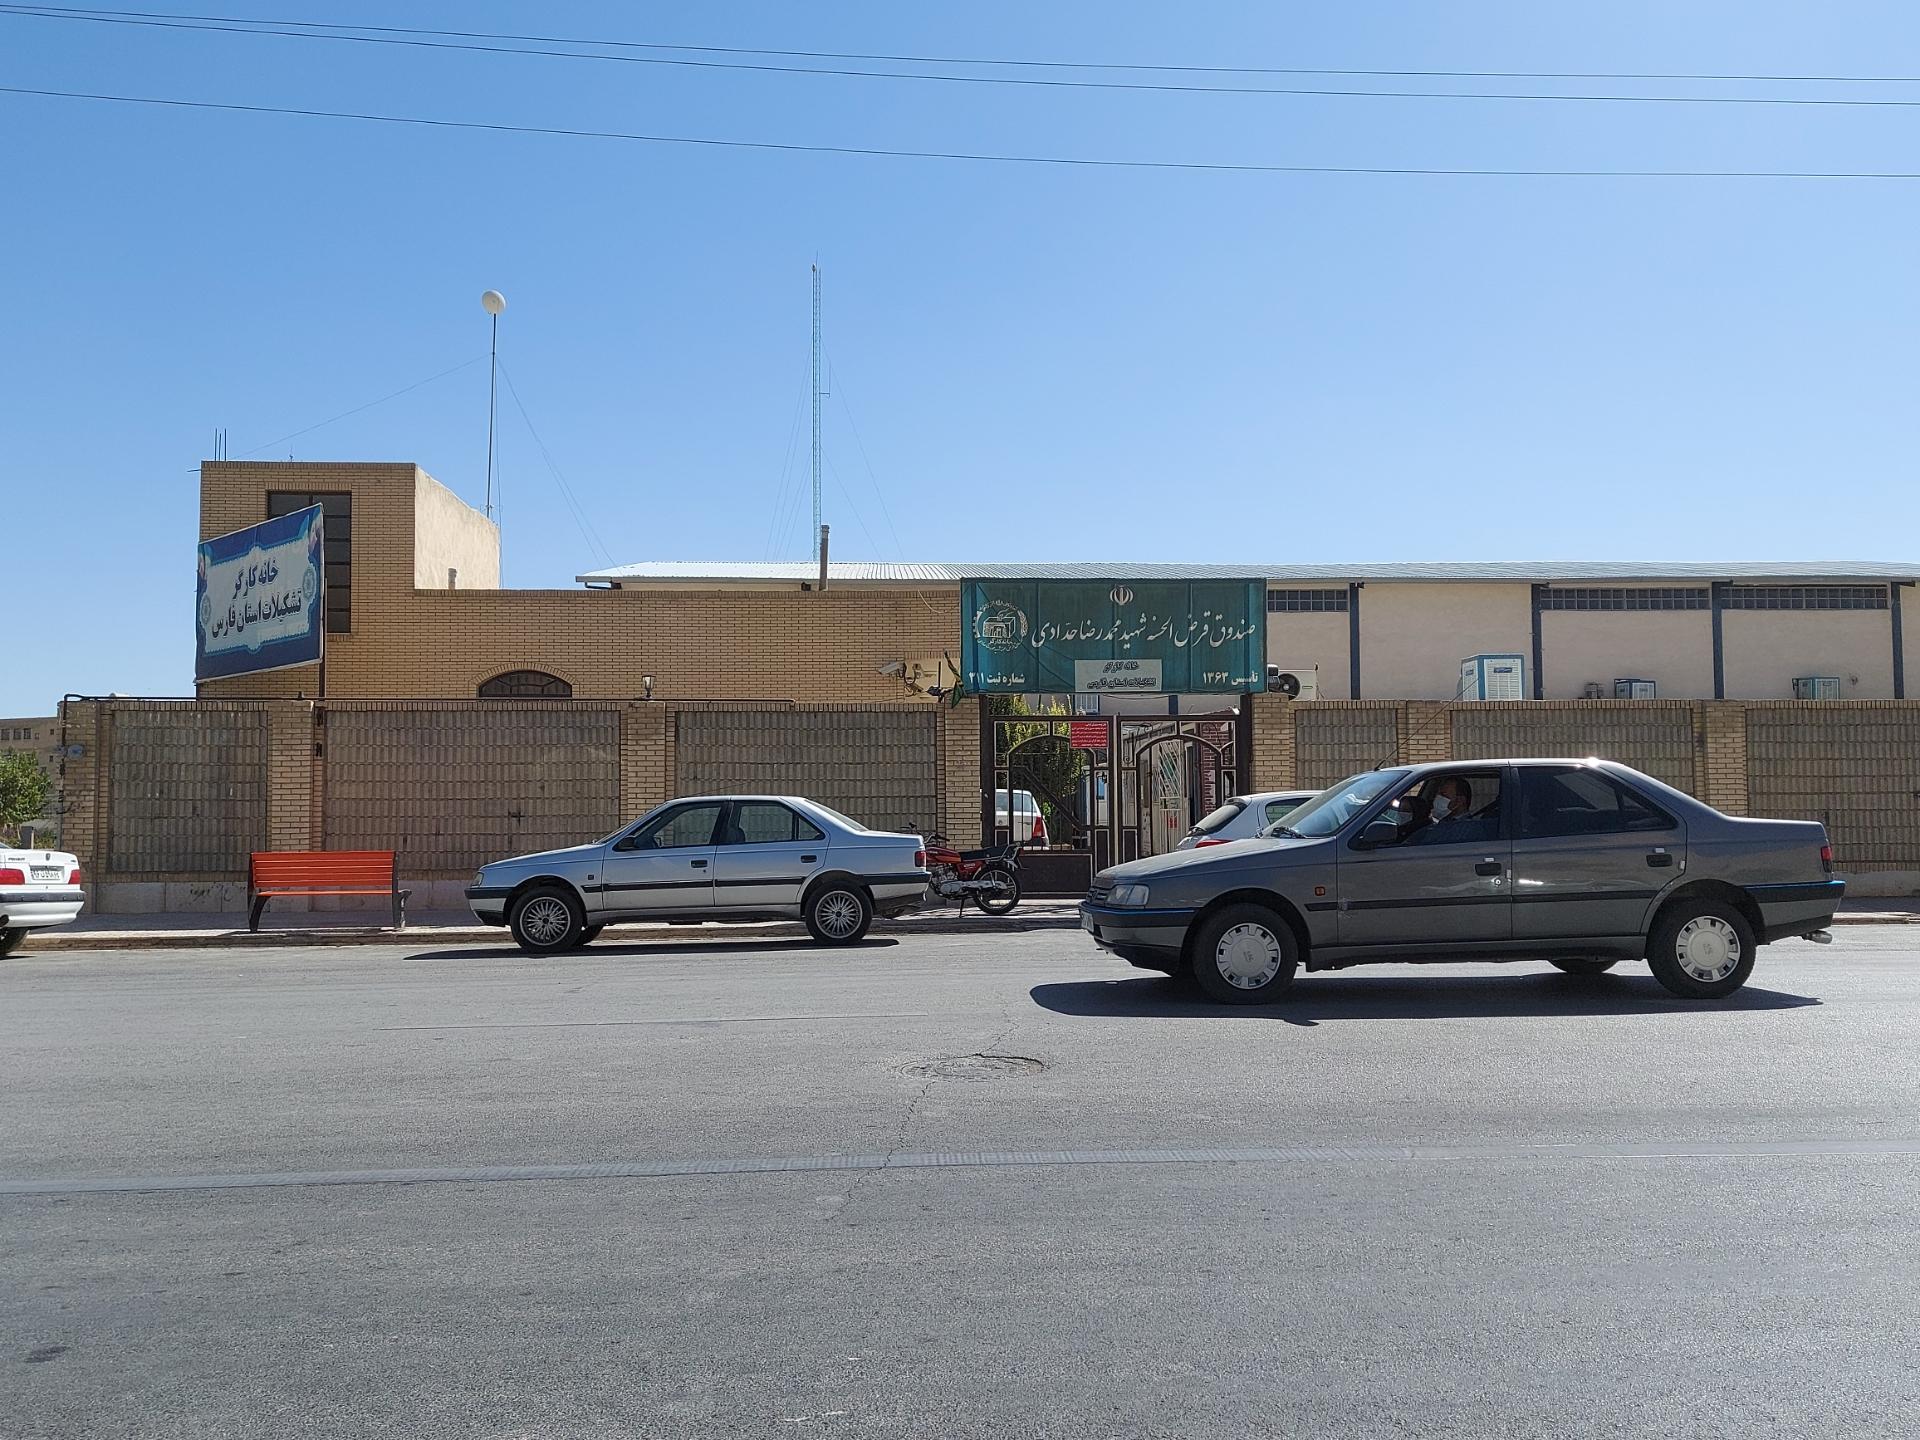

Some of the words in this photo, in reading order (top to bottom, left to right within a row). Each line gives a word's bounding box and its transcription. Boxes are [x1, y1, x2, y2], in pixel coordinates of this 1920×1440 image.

[232, 564, 258, 599] کارگر
[258, 559, 279, 584] خانه
[212, 604, 236, 638] فارس
[237, 598, 262, 632] استان
[262, 590, 302, 622] تشکیلات
[1118, 613, 1147, 649] شهید
[1174, 611, 1211, 648] قرض
[1209, 614, 1256, 648] صندوق
[986, 672, 1001, 686] ثبت
[1002, 672, 1026, 687] شماره
[1203, 671, 1229, 685] ۱۳۶۳
